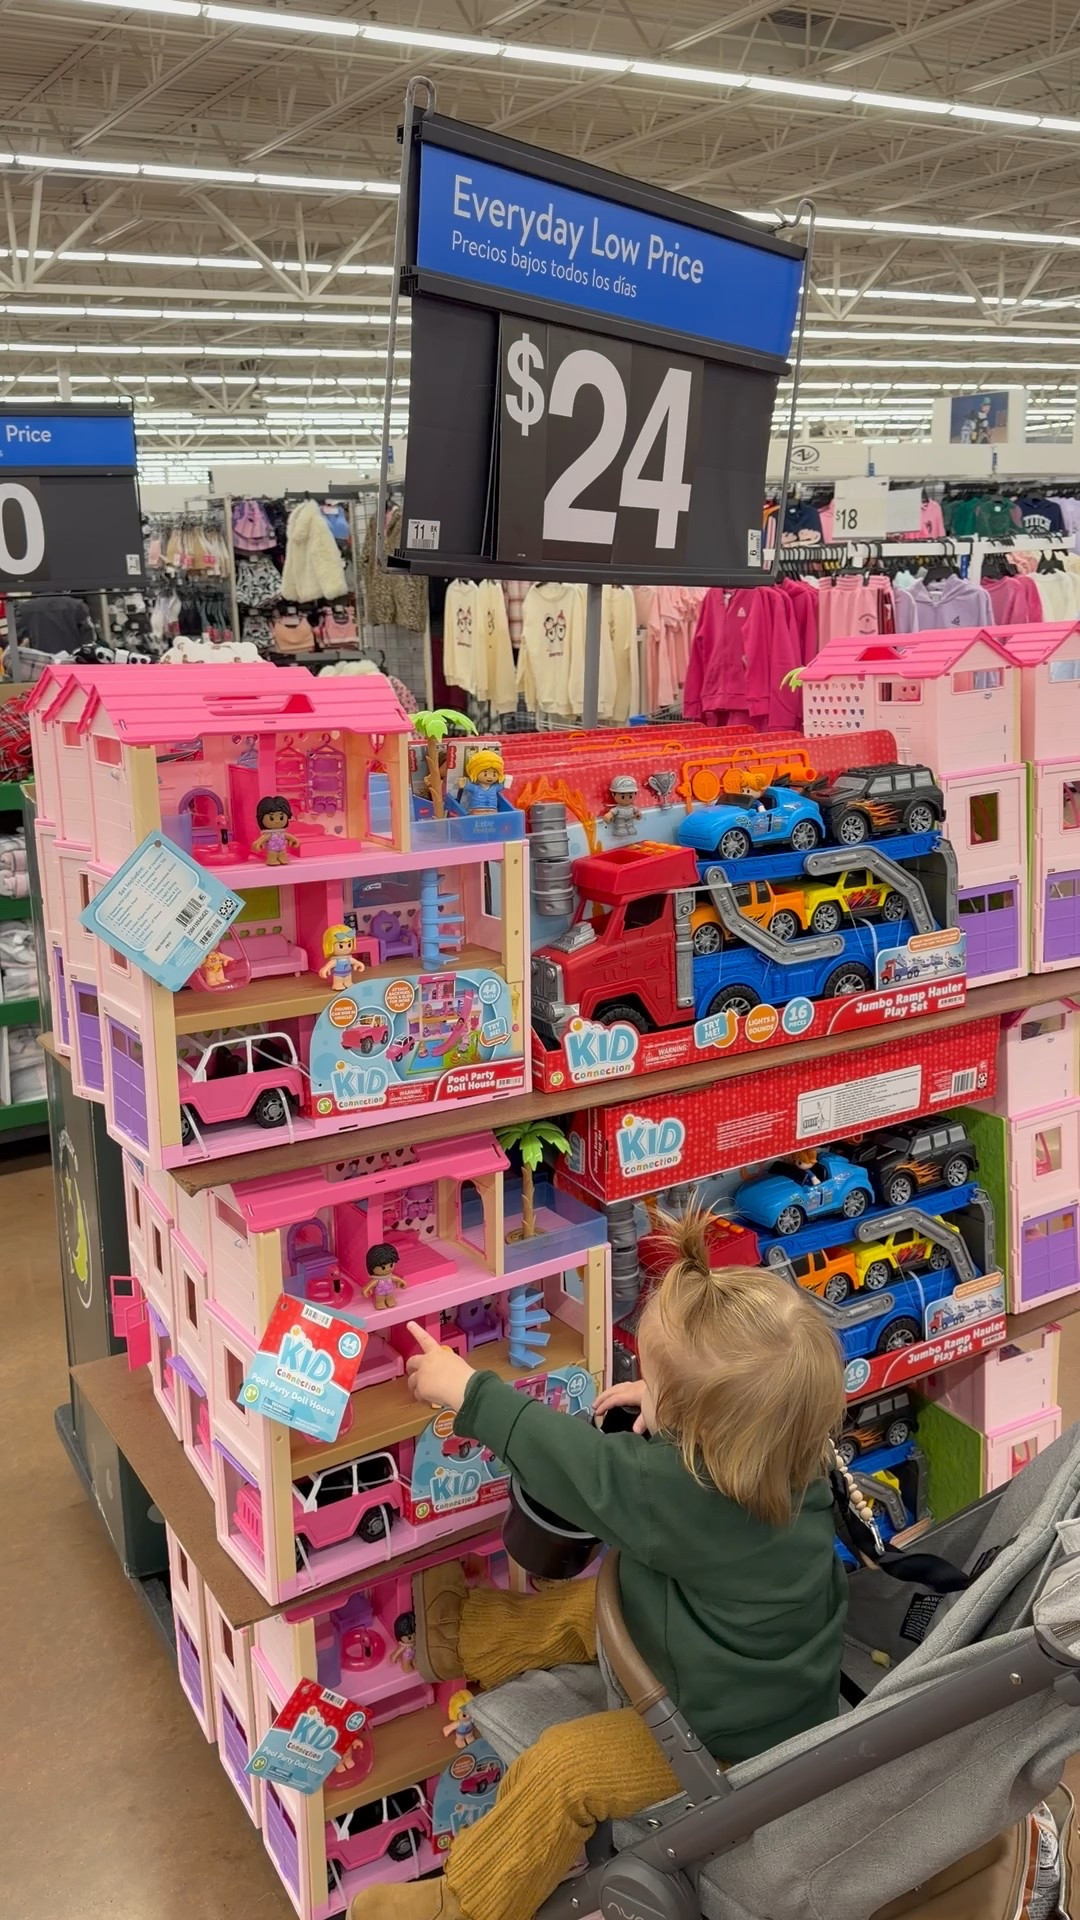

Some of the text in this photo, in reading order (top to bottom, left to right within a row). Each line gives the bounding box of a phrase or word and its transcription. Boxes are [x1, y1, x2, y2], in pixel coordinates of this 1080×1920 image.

[453, 174, 704, 283] Everyday Low Price
[452, 230, 637, 298] Precios bajos todos los días
[6, 424, 51, 443] Price
[506, 332, 692, 549] $24
[836, 508, 858, 530] $18
[414, 524, 425, 539] 11
[855, 983, 963, 1014] Jumbo Ramp Hauler
[788, 1004, 808, 1021] 16
[884, 1000, 928, 1018] Play Set
[487, 1021, 500, 1030] TRY
[702, 1018, 720, 1031] TRY
[748, 1017, 770, 1027] LIGHTS
[748, 1024, 775, 1035] SOUNDS
[788, 1020, 807, 1029] PIECES
[704, 1027, 720, 1039] ME!
[568, 1028, 630, 1069] KID
[447, 1071, 495, 1084] Pool Party
[574, 1064, 631, 1081] Connection
[333, 1069, 386, 1098] KID
[446, 1083, 466, 1093] Doll
[468, 1079, 495, 1090] House
[338, 1097, 384, 1108] Connection
[620, 1120, 682, 1164] KID
[624, 1154, 679, 1175] Connection
[907, 1321, 1005, 1364] Jumbo Ramp Hauler
[280, 1336, 332, 1382] KID
[933, 1342, 973, 1364] Play Set
[277, 1368, 322, 1393] Connection
[847, 1364, 865, 1381] 16
[251, 1372, 269, 1388] Pool
[270, 1380, 291, 1398] Party
[291, 1391, 308, 1406] Doll
[309, 1398, 336, 1417] House
[432, 1470, 480, 1501] KID
[435, 1495, 477, 1511] Connection
[292, 1716, 336, 1751] KID
[262, 1746, 277, 1757] Pool
[277, 1752, 294, 1765] Party
[294, 1759, 307, 1770] Doll
[287, 1742, 321, 1760] Connection
